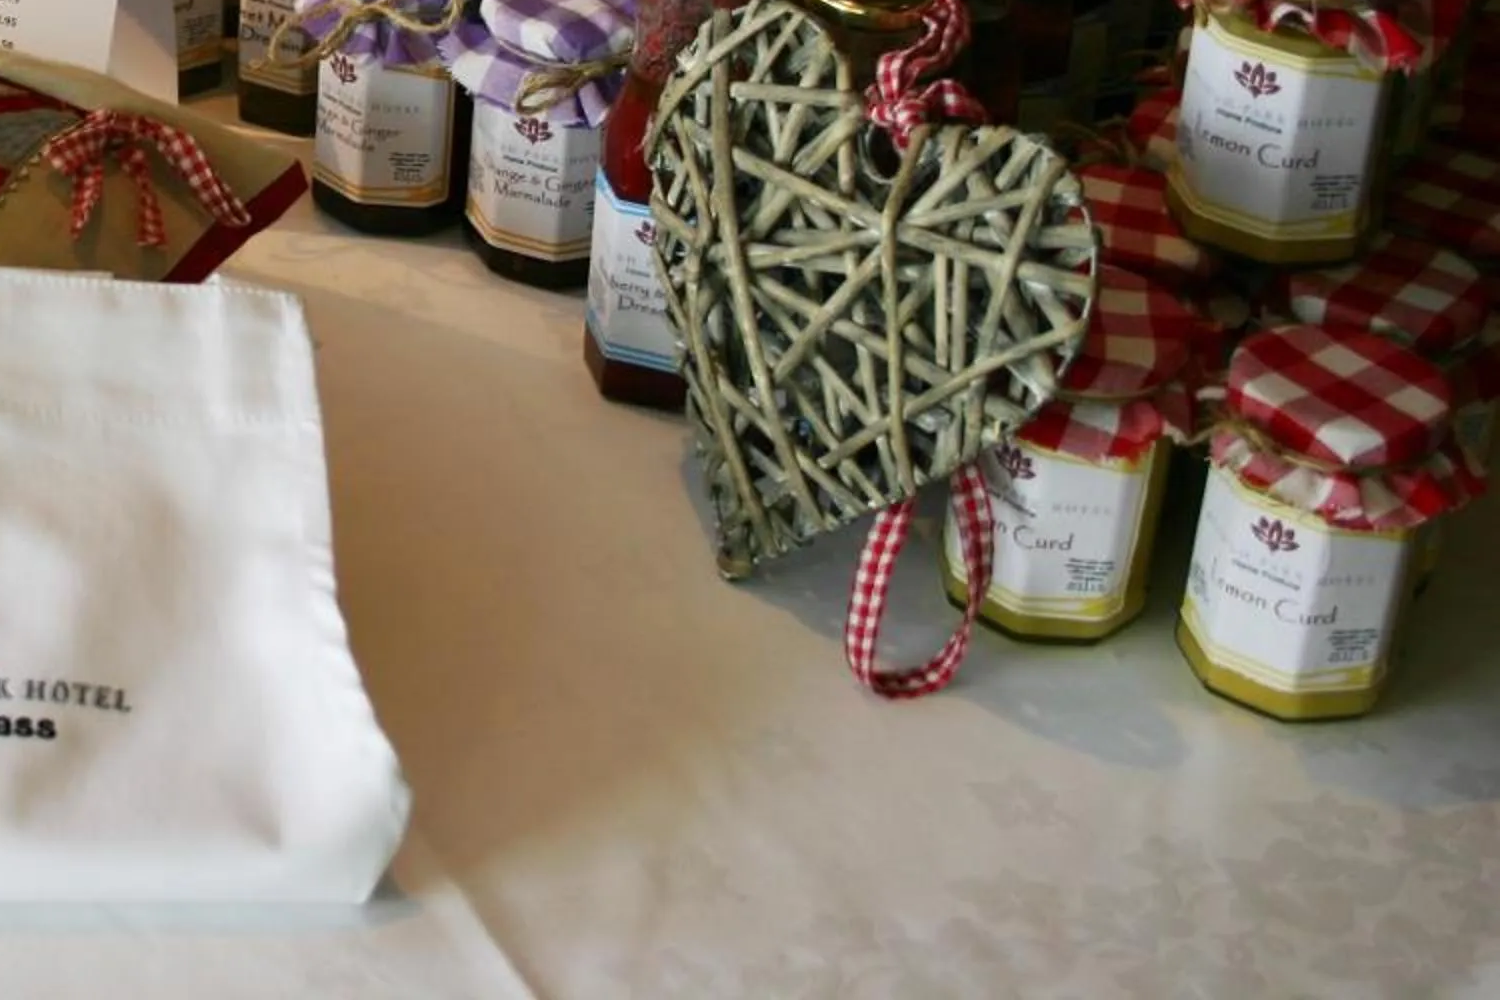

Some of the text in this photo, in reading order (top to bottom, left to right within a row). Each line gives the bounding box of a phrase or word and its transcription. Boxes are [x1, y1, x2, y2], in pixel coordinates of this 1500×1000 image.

[1257, 142, 1320, 170] Curd
[1013, 524, 1075, 551] Curd
[1273, 599, 1338, 625] Curd
[24, 682, 133, 713] HOTEL
